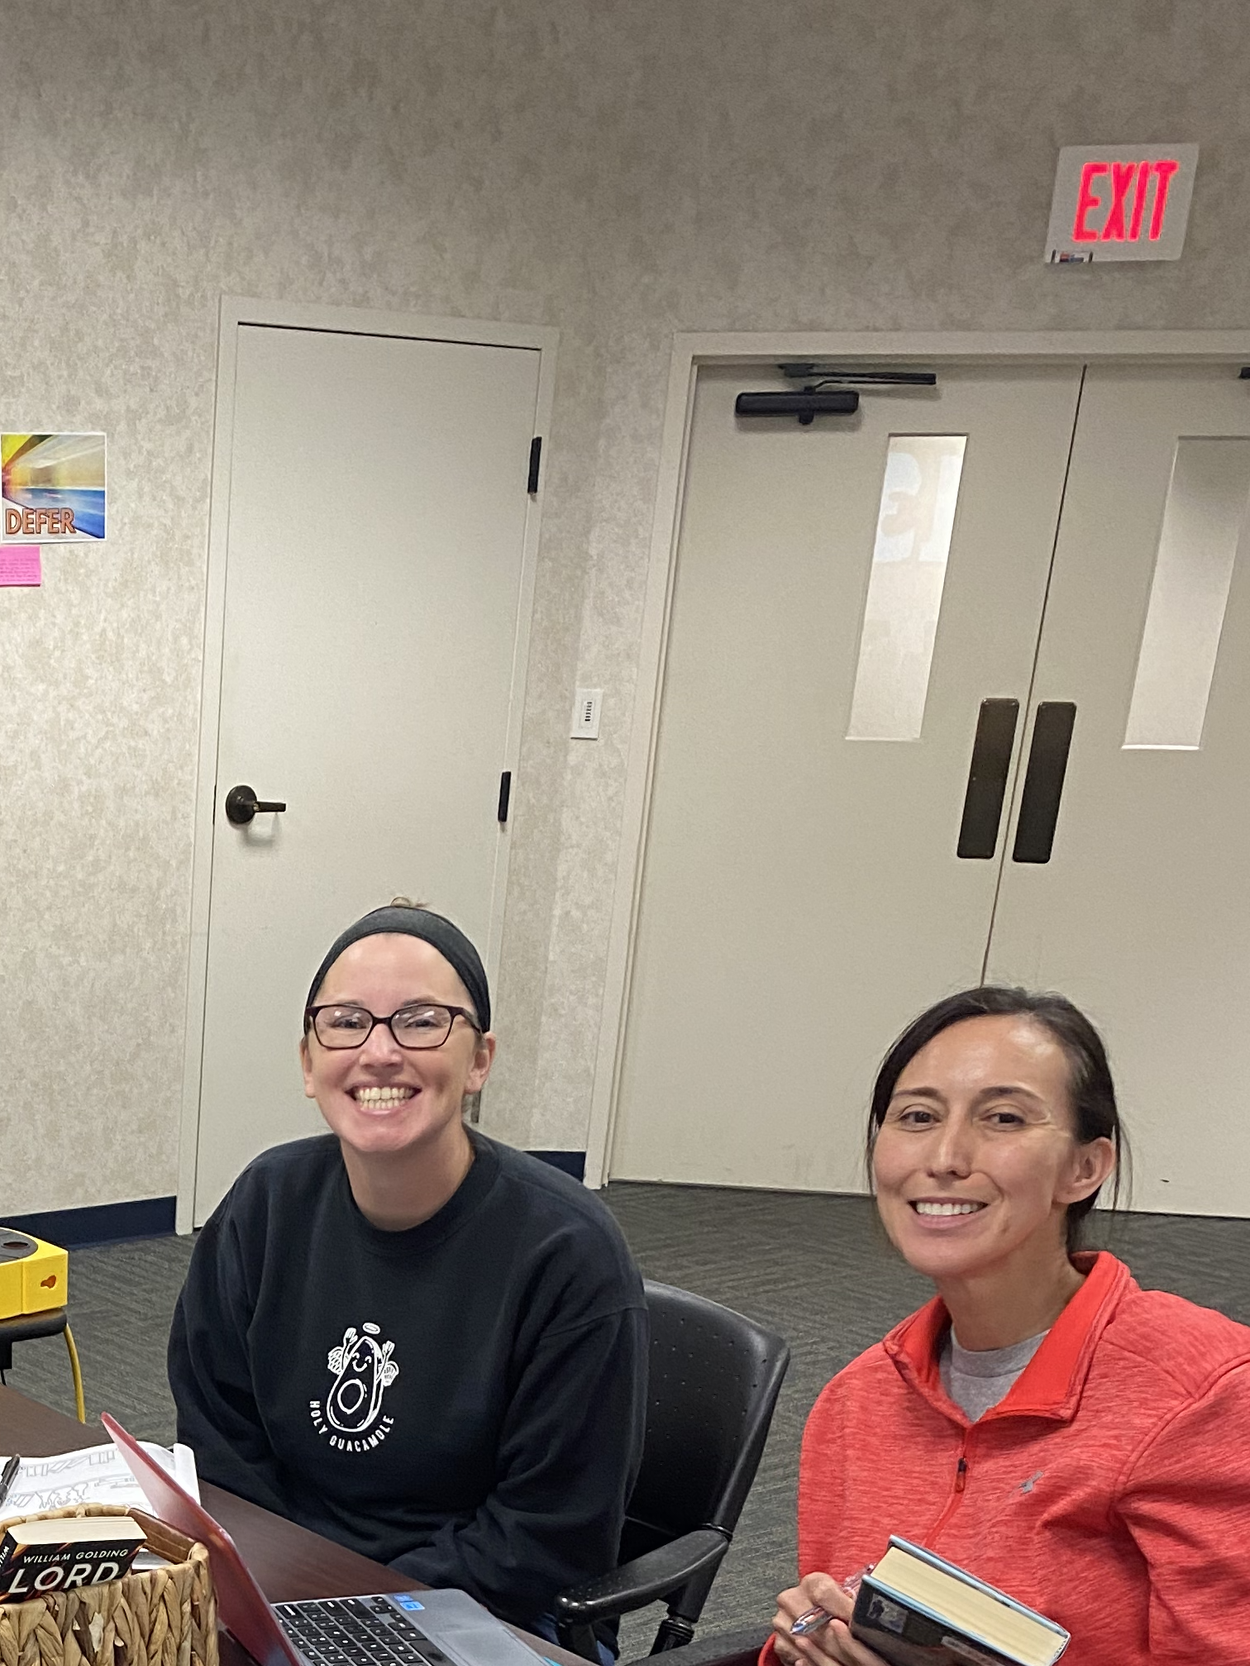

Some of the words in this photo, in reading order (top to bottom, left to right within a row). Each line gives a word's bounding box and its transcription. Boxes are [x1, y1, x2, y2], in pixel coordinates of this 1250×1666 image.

[1072, 160, 1179, 242] EXIT
[5, 508, 76, 535] DEFER
[309, 1400, 328, 1435] HOLY
[329, 1415, 395, 1452] GUACAMOLE
[23, 1553, 71, 1564] WILLIAM
[75, 1548, 129, 1560] GOLDING
[8, 1561, 120, 1594] LORD
